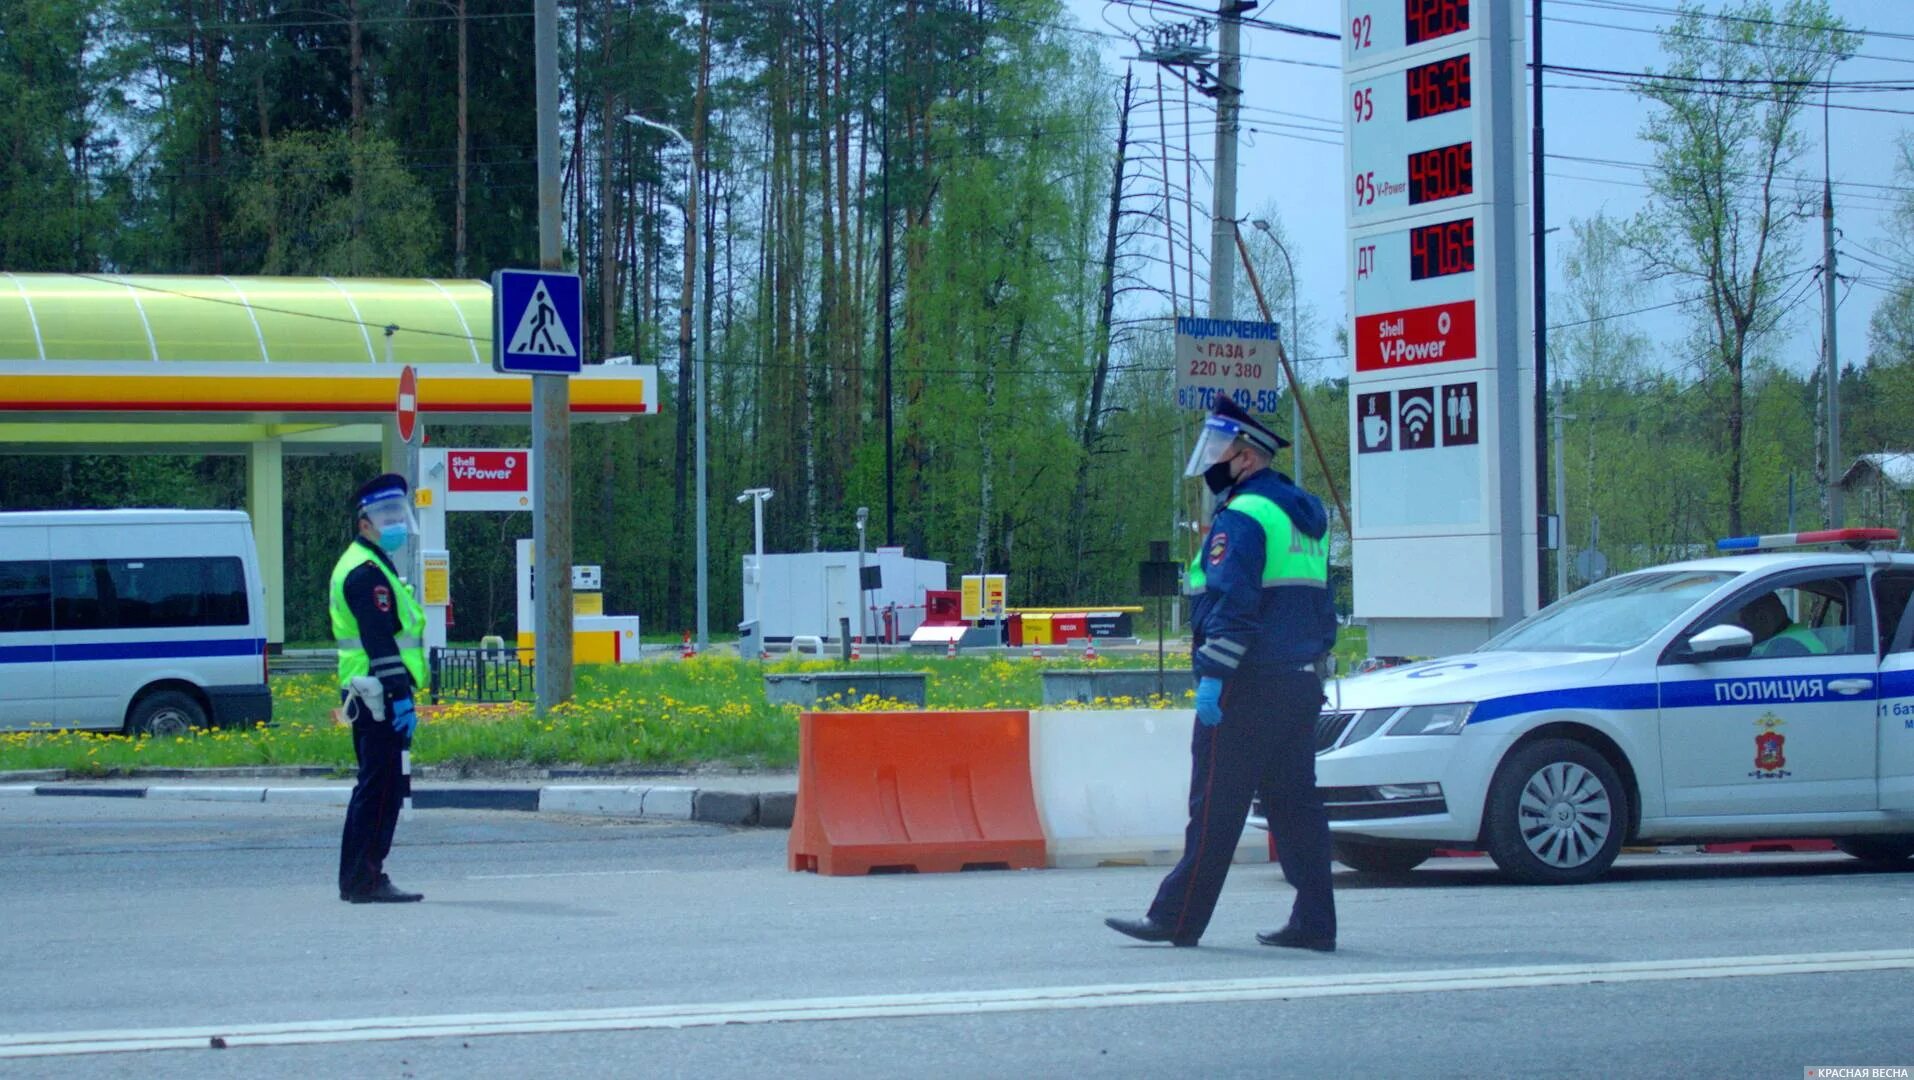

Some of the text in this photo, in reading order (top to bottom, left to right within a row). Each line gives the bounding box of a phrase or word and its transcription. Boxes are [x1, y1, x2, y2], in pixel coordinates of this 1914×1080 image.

[1353, 15, 1371, 50] 92
[1354, 88, 1373, 123] 95
[1356, 172, 1375, 207] 95
[1377, 182, 1406, 196] V-Power
[1358, 245, 1376, 280] ДТ
[1177, 317, 1278, 340] ПОДКЛЮЧЕНИЕ
[1379, 318, 1404, 338] Shell
[1208, 343, 1244, 359] ГАЗА
[1380, 339, 1446, 364] V-Power
[1190, 360, 1217, 377] 220
[1235, 363, 1262, 379] 380
[452, 456, 475, 466] Shell
[453, 467, 512, 479] V-Power
[1714, 679, 1825, 701] ПОЛИЦИЯ
